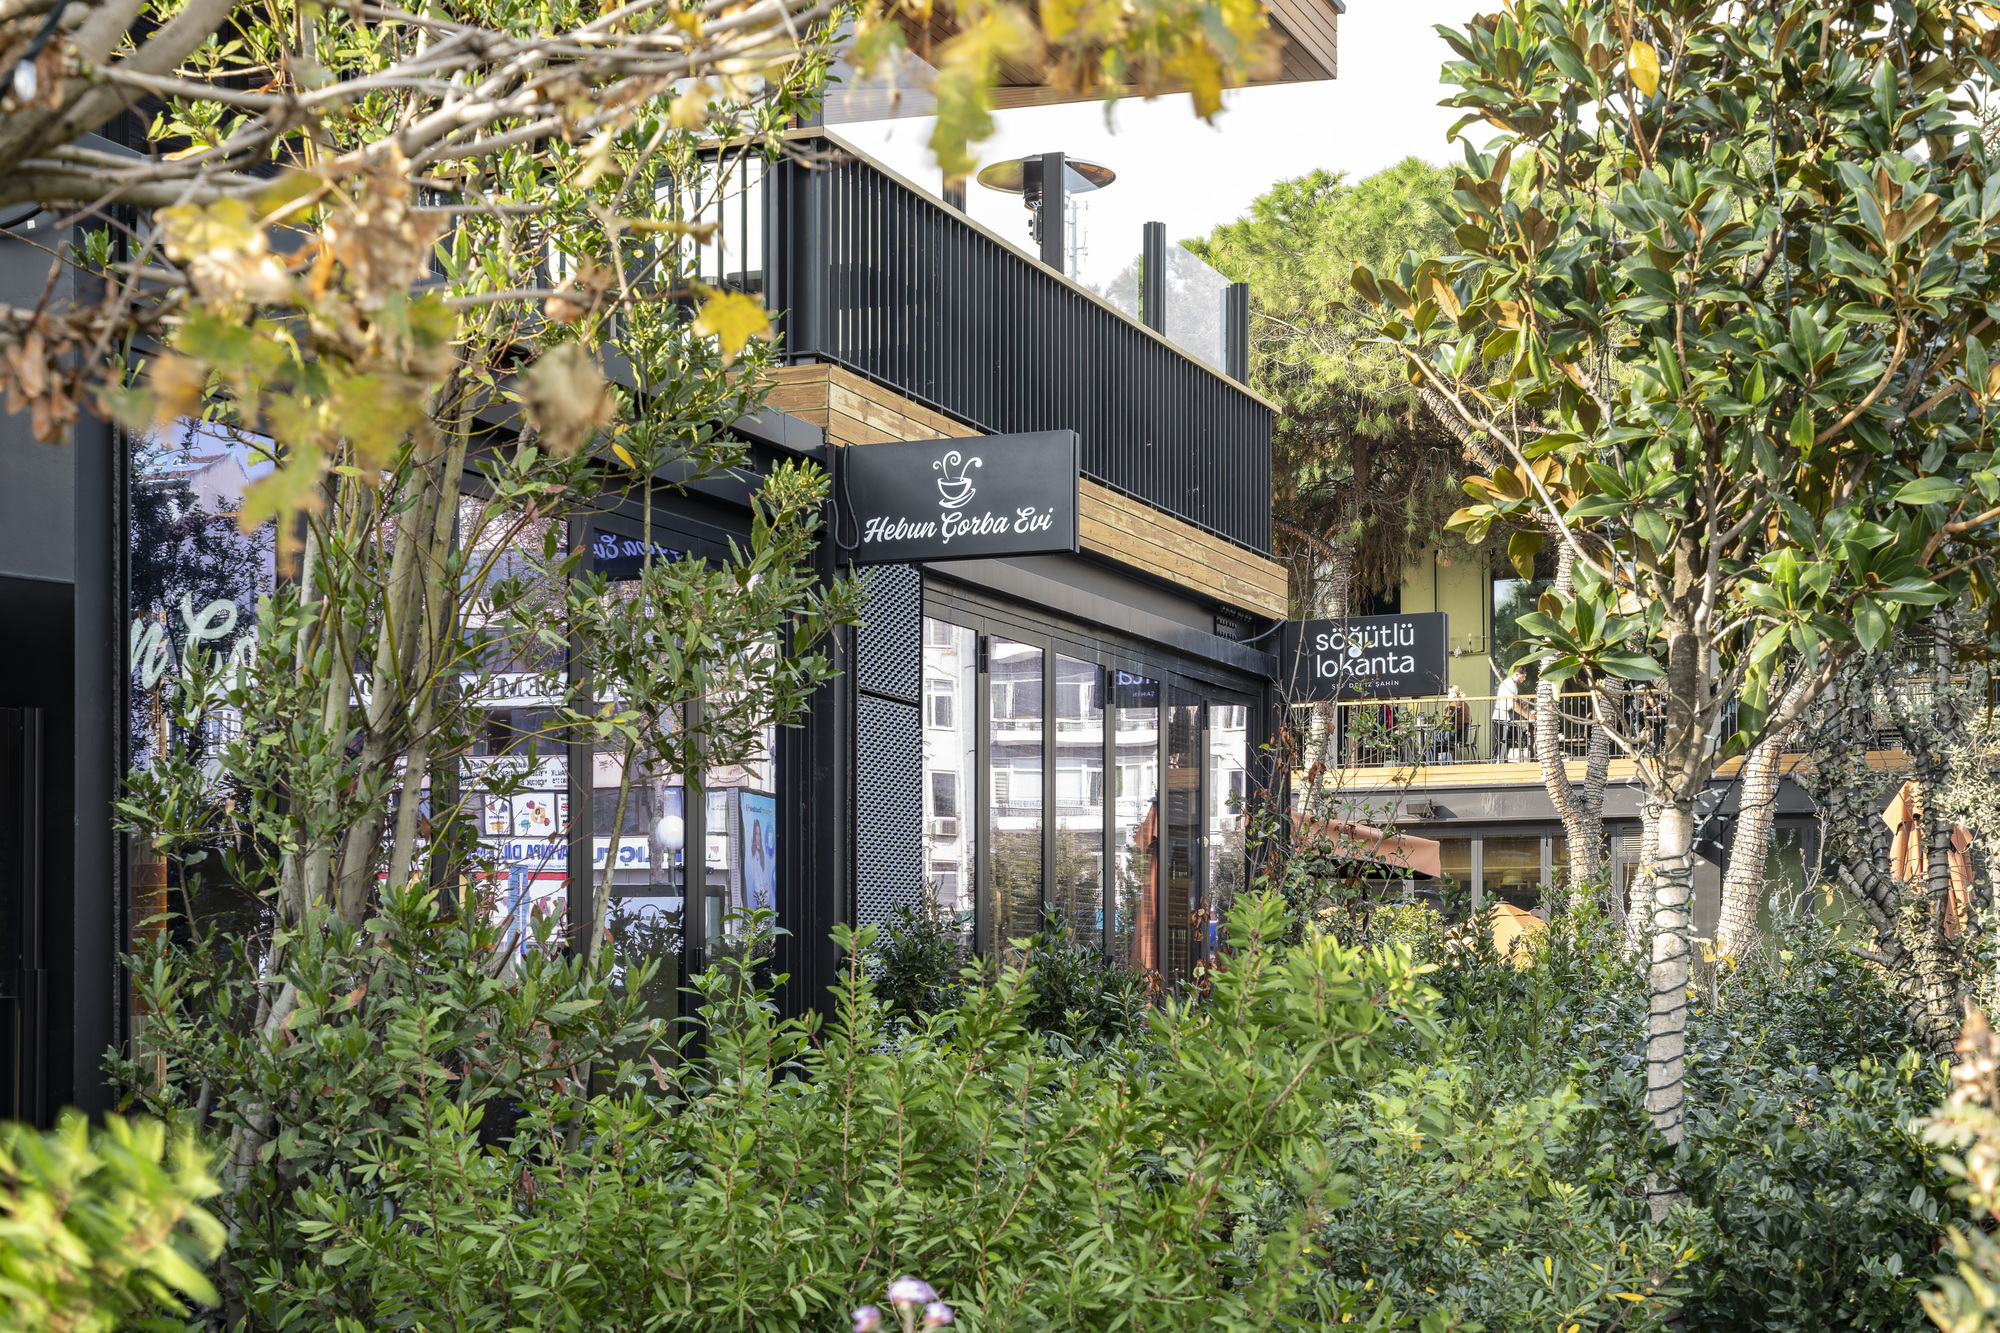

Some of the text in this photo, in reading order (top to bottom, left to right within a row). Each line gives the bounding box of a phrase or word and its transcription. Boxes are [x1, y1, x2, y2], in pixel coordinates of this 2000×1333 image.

[864, 507, 1054, 544] Hebun Çorba Evi
[1316, 622, 1415, 658] söğütlü
[1316, 651, 1415, 678] lokanta
[1375, 679, 1399, 688] ŞAHİN
